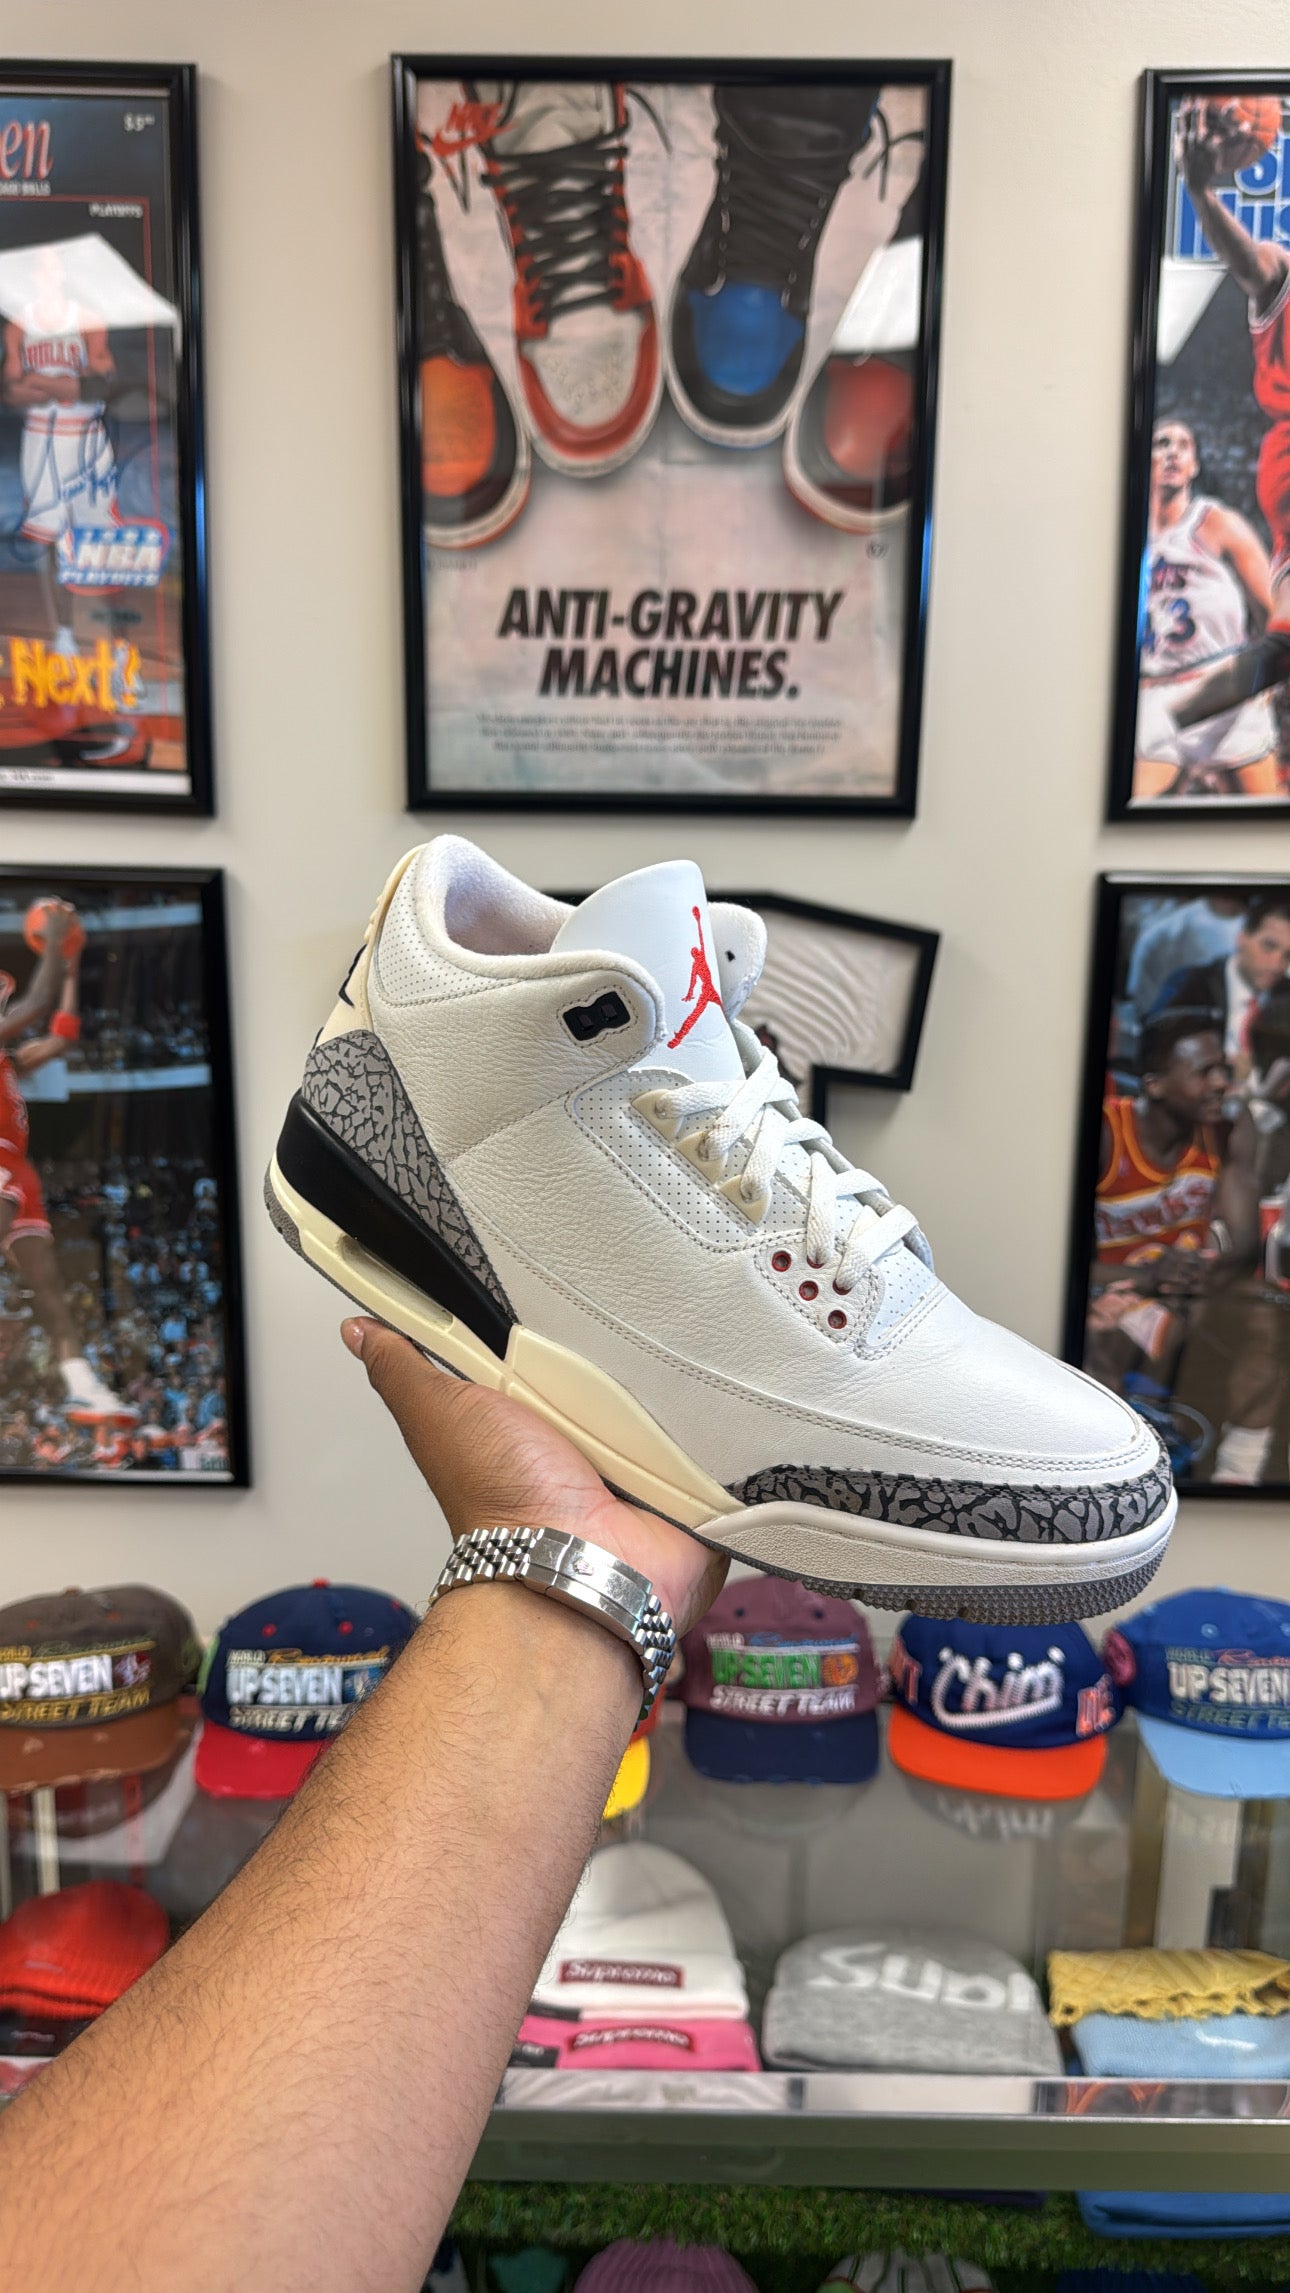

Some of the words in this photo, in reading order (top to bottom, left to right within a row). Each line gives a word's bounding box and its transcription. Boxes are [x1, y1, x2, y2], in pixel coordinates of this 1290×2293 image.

[78, 543, 161, 572] NBA
[498, 588, 847, 642] ANTI-GRAVITY
[538, 647, 800, 700] MACHINES.
[87, 1686, 150, 1717] TEAM
[710, 1685, 795, 1717] STREET
[797, 1688, 856, 1717] TEAM
[1169, 1699, 1261, 1730] STREET
[230, 1706, 312, 1733] STREET
[566, 1962, 677, 1984] Supreme
[575, 2026, 690, 2048] Supreme
